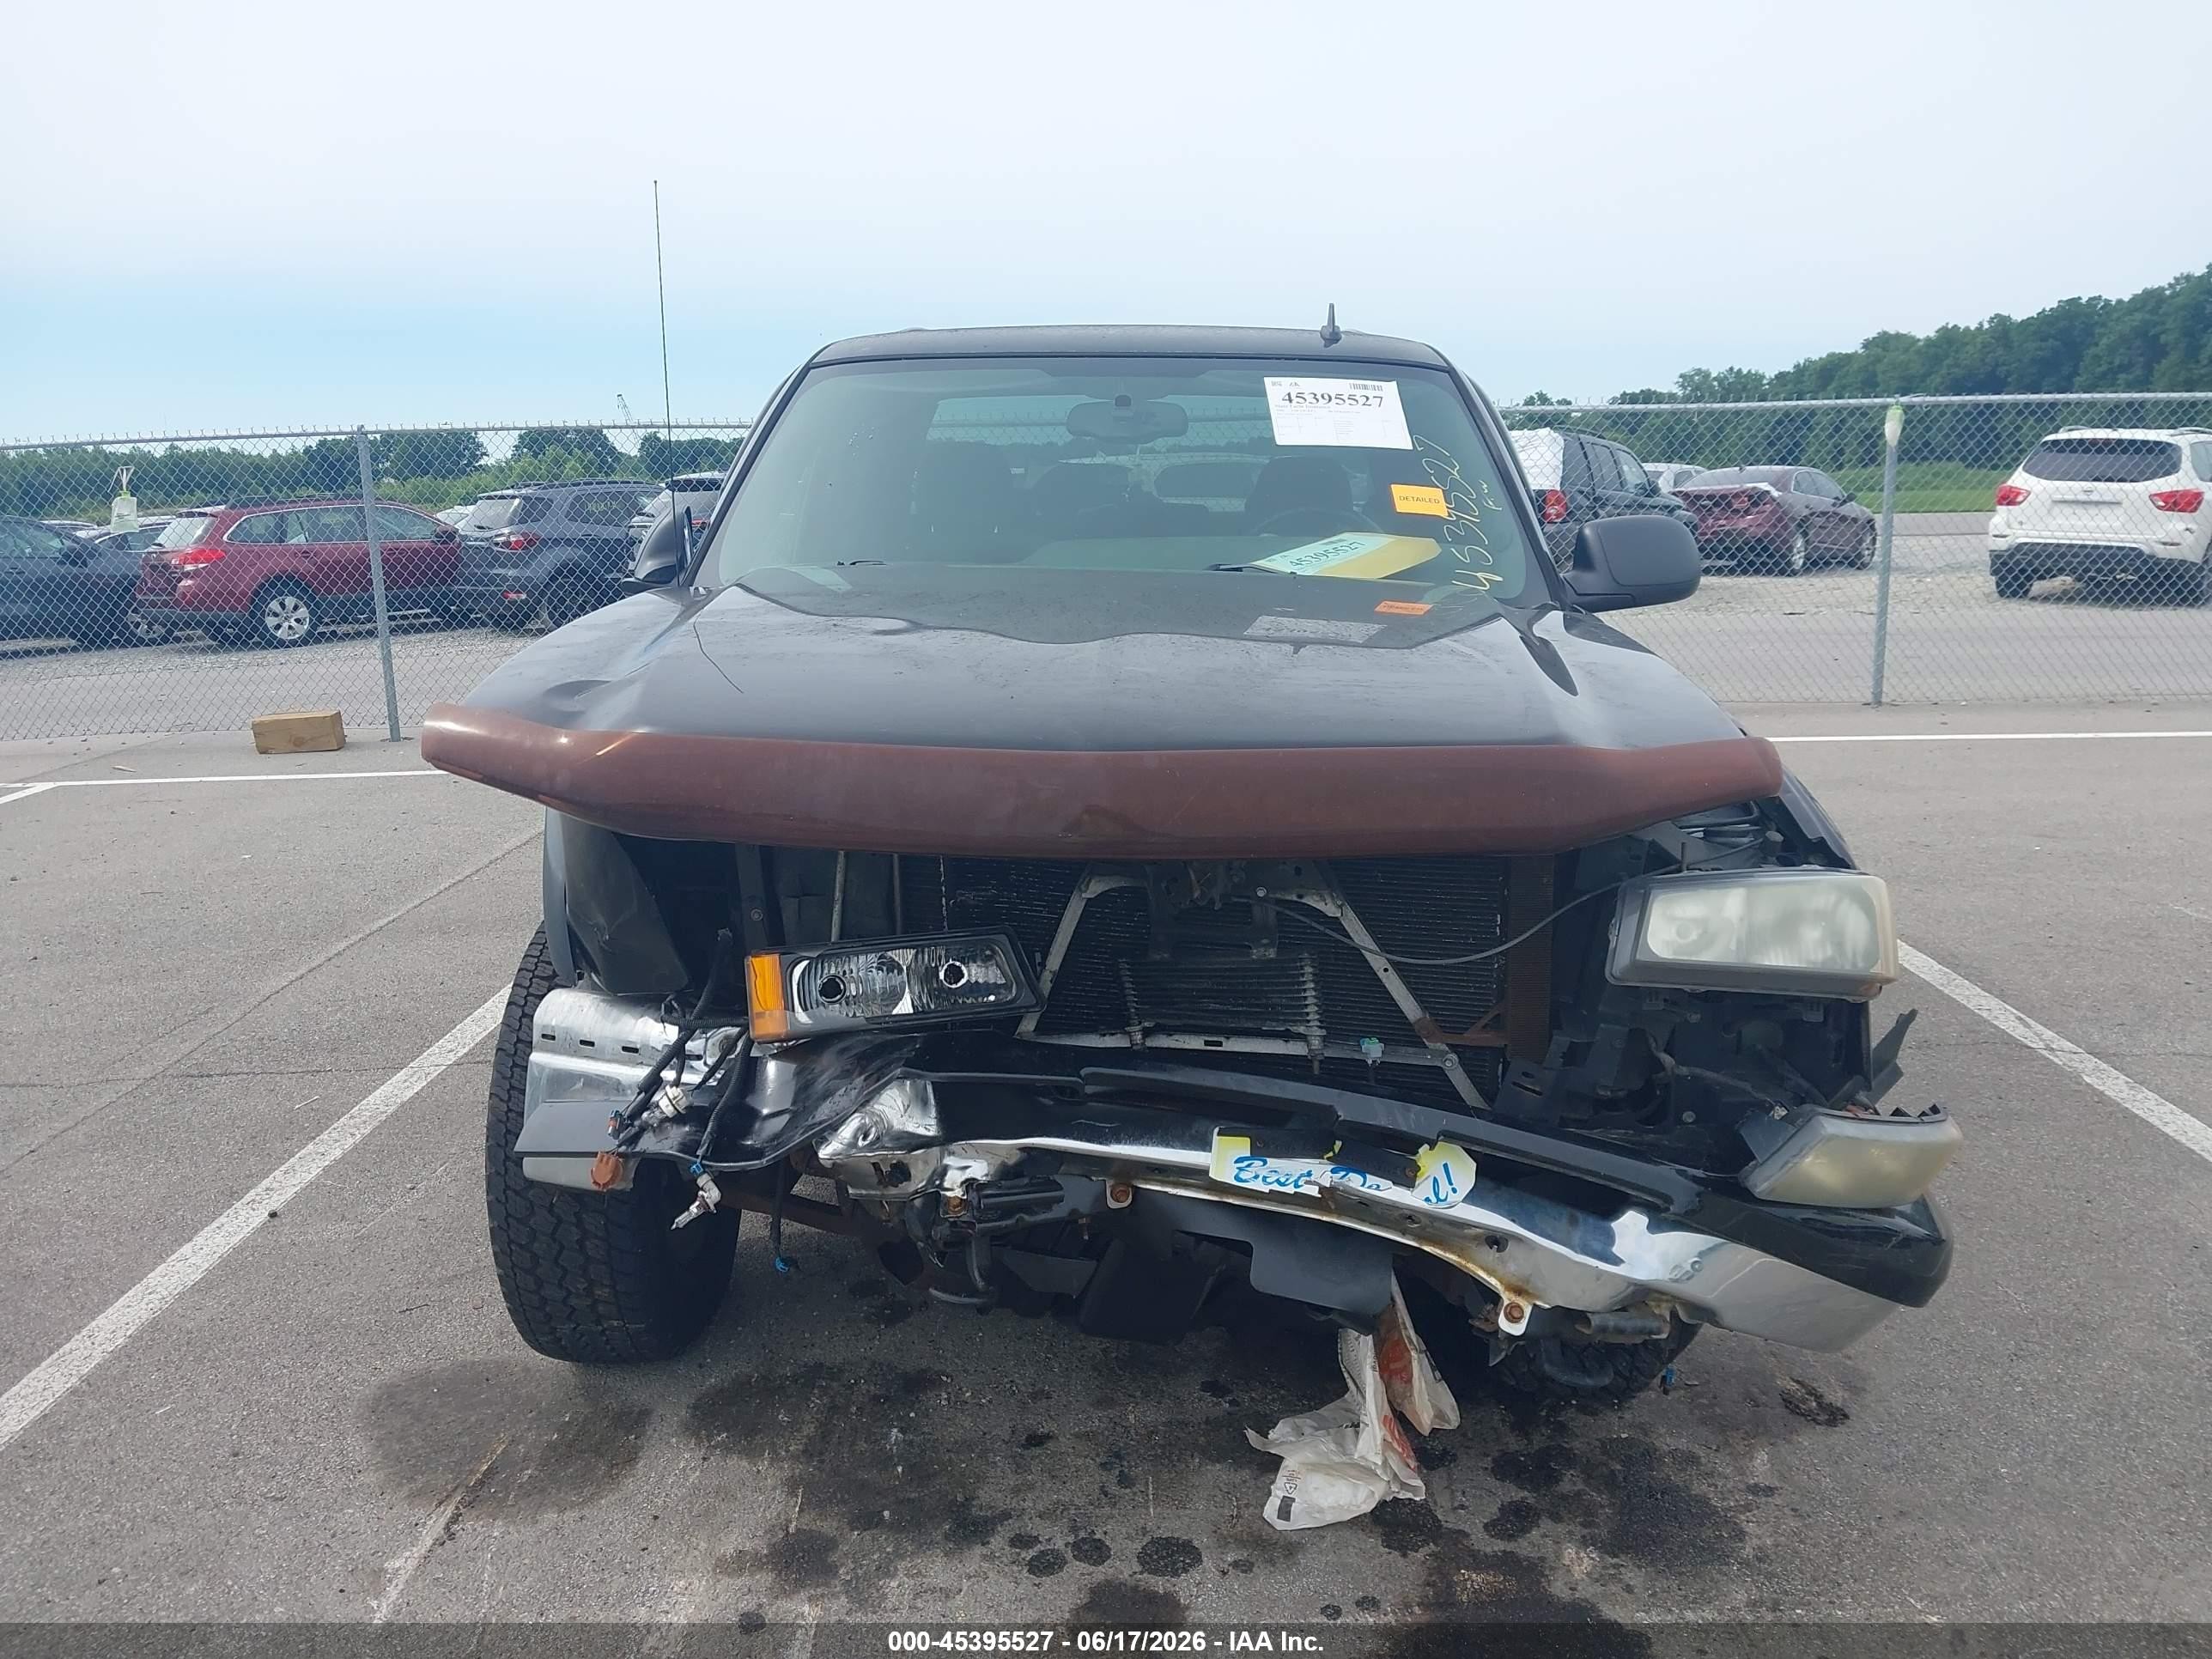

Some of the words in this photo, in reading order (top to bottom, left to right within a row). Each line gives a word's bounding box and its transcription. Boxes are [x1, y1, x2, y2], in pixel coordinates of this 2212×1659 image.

[1282, 392, 1383, 408] 45395527
[1398, 495, 1440, 505] DETAILED
[1413, 434, 1504, 590] 45395527
[1289, 540, 1365, 568] 45395527
